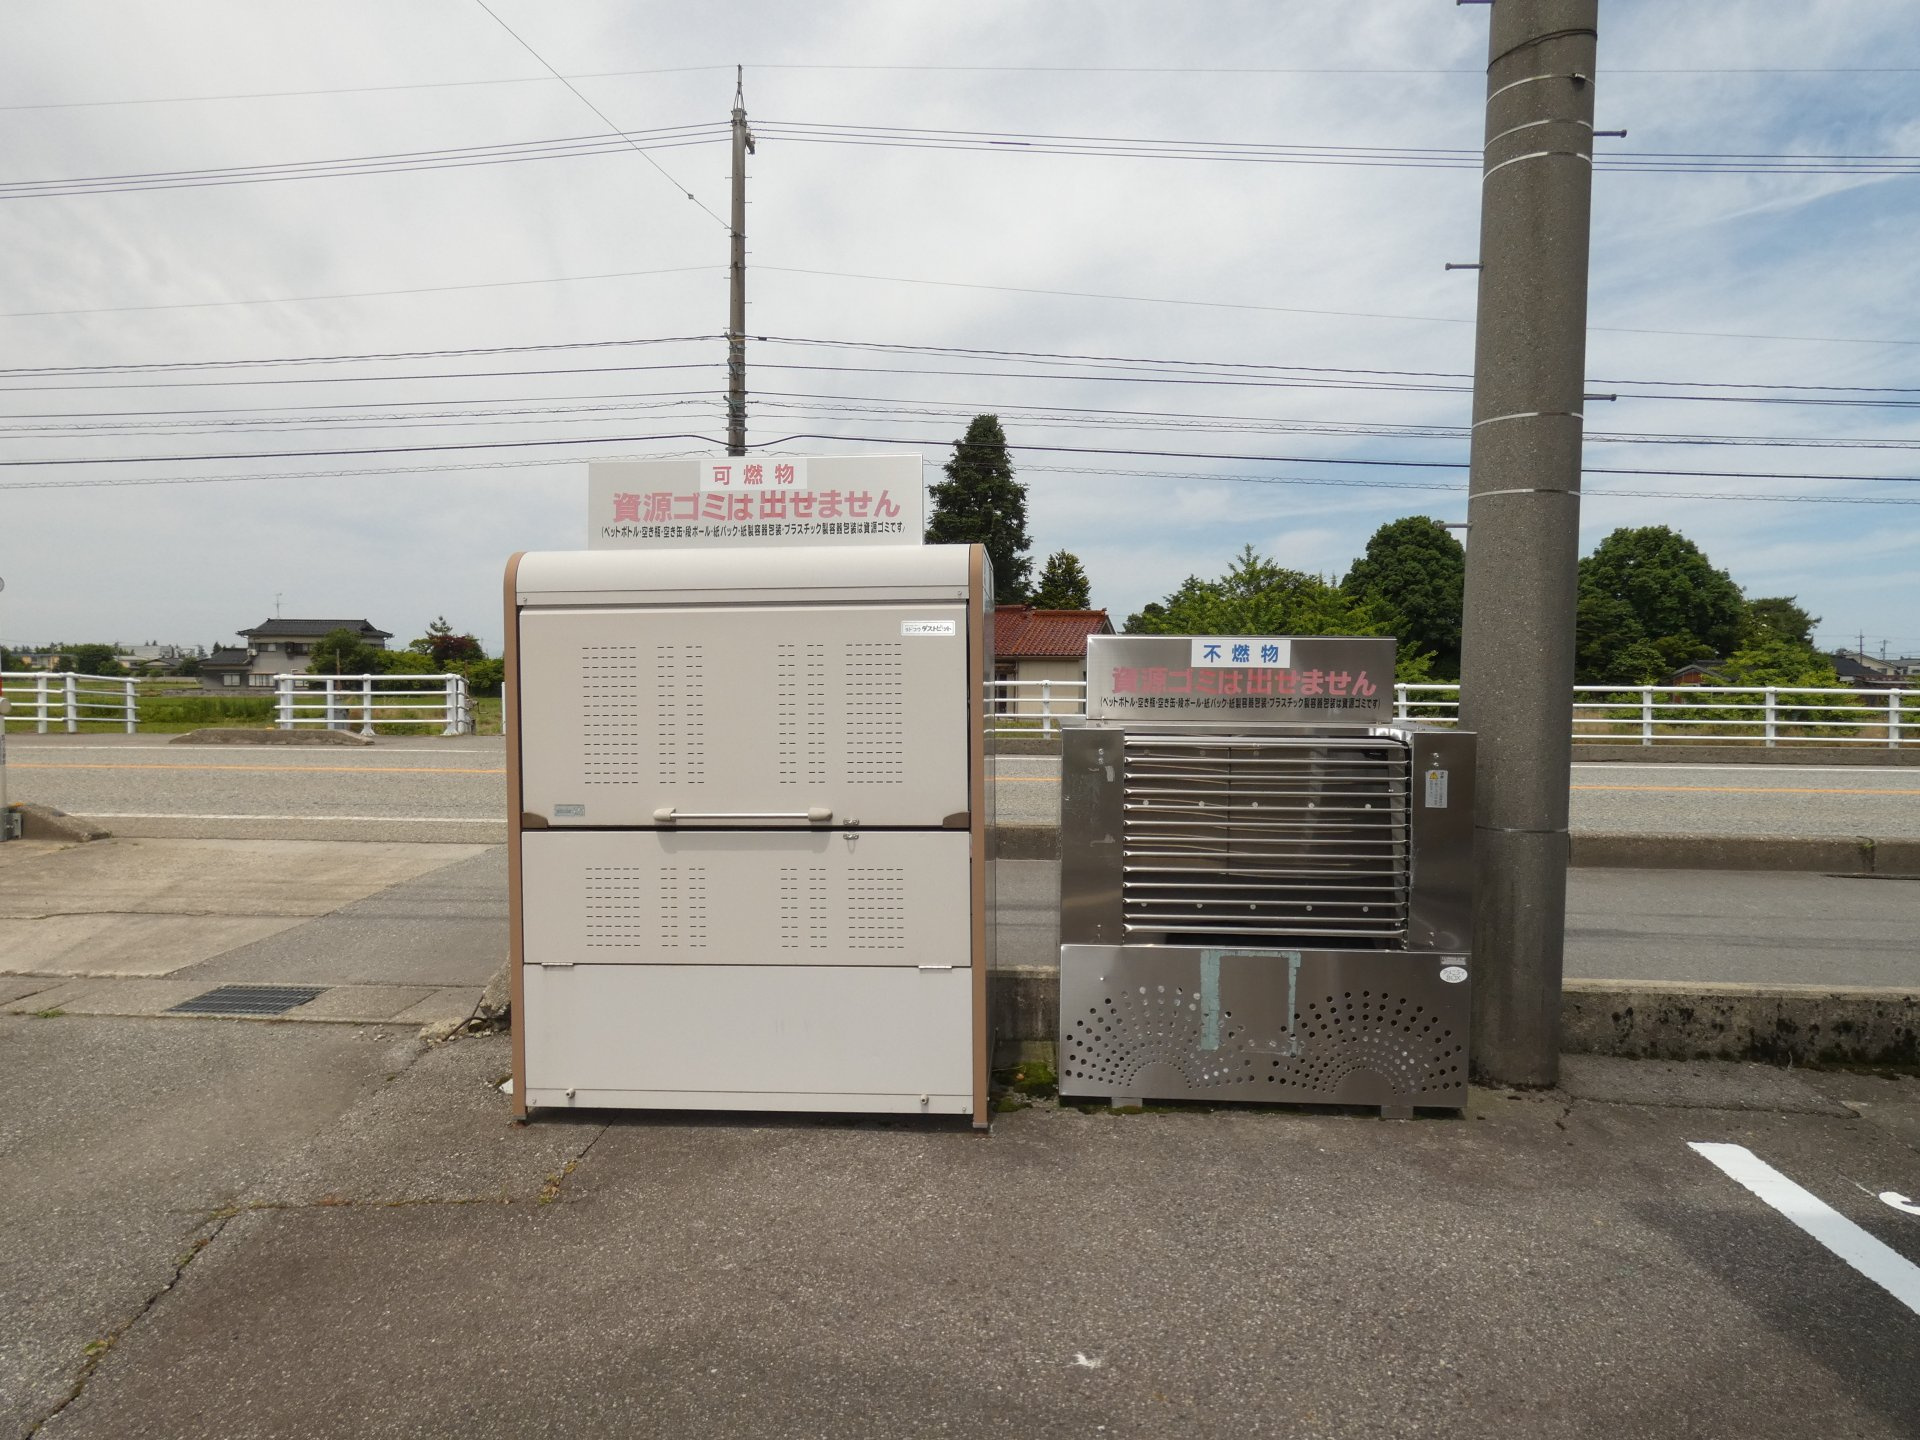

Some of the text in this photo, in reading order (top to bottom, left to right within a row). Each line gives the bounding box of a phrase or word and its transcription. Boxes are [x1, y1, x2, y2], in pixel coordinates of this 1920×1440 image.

[712, 464, 795, 485] 可燃物
[612, 489, 901, 522] 資源ゴミは出せません
[1203, 643, 1280, 664] 不燃物
[1111, 666, 1377, 697] 資源ゴミは出せません
